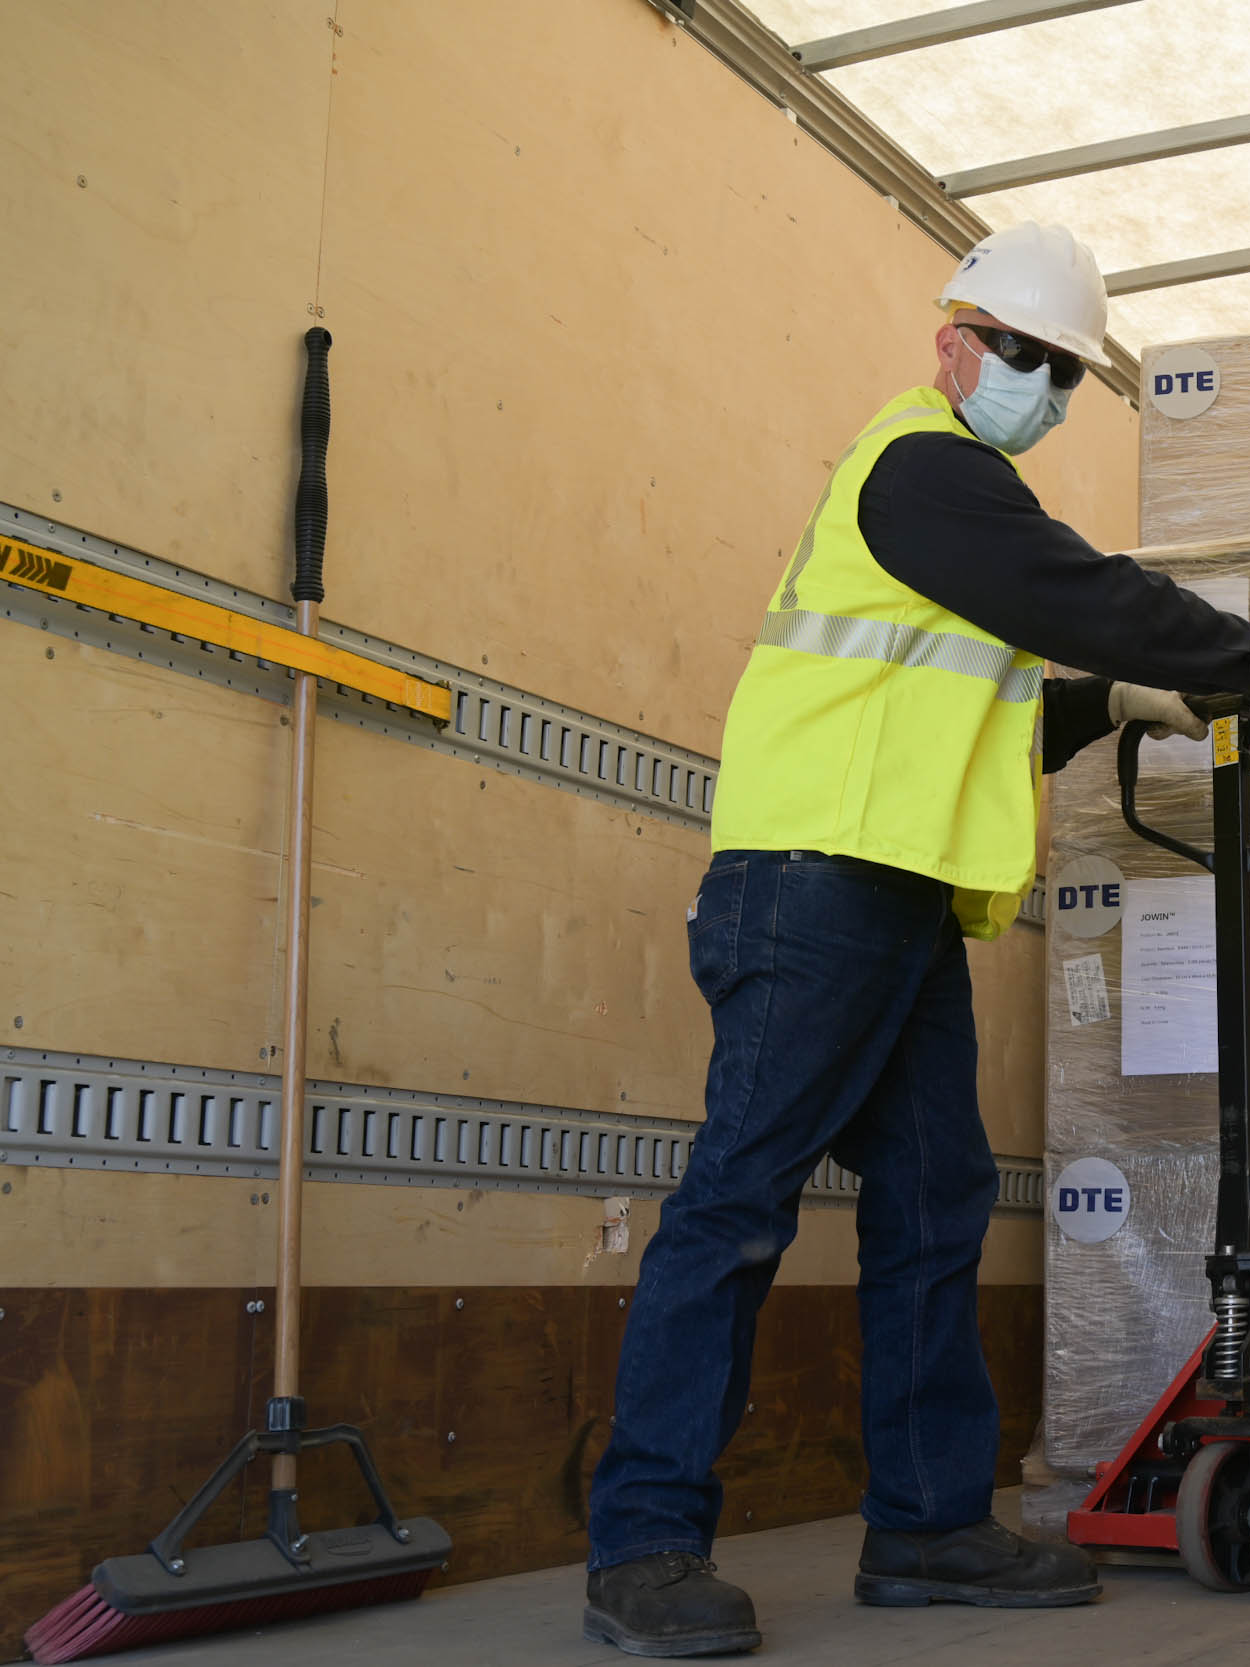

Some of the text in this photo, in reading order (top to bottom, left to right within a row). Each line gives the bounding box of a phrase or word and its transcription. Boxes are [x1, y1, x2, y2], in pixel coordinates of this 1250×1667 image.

[1154, 370, 1214, 396] DTE
[1058, 883, 1121, 911] DTE
[1058, 1187, 1123, 1213] DTE
